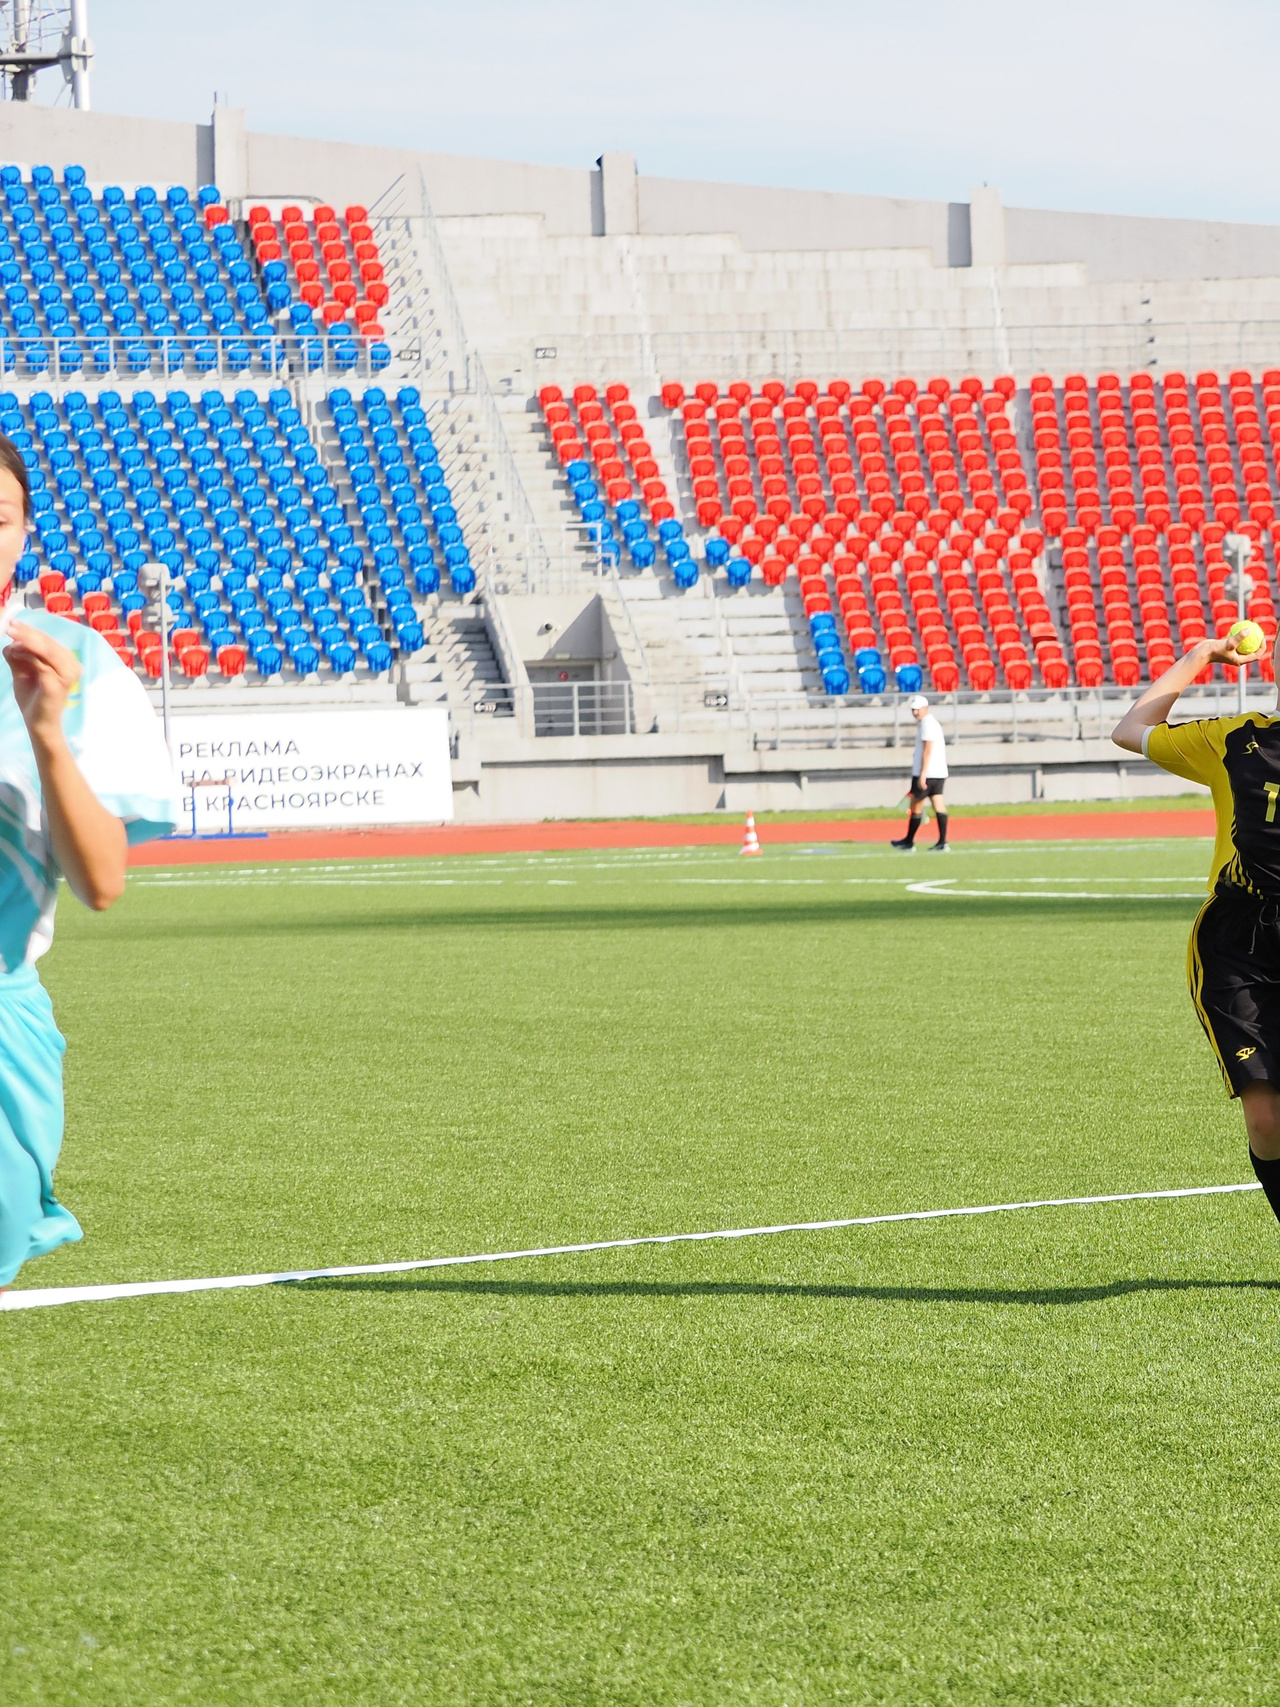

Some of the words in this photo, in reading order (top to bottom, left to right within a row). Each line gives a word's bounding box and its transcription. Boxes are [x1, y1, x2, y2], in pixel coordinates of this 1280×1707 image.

[180, 740, 300, 758] РЕКЛАМА
[181, 768, 213, 785] НА
[183, 795, 195, 812] В
[206, 790, 386, 812] КРАСНОЯРСКЕ
[1263, 781, 1280, 823] 1
